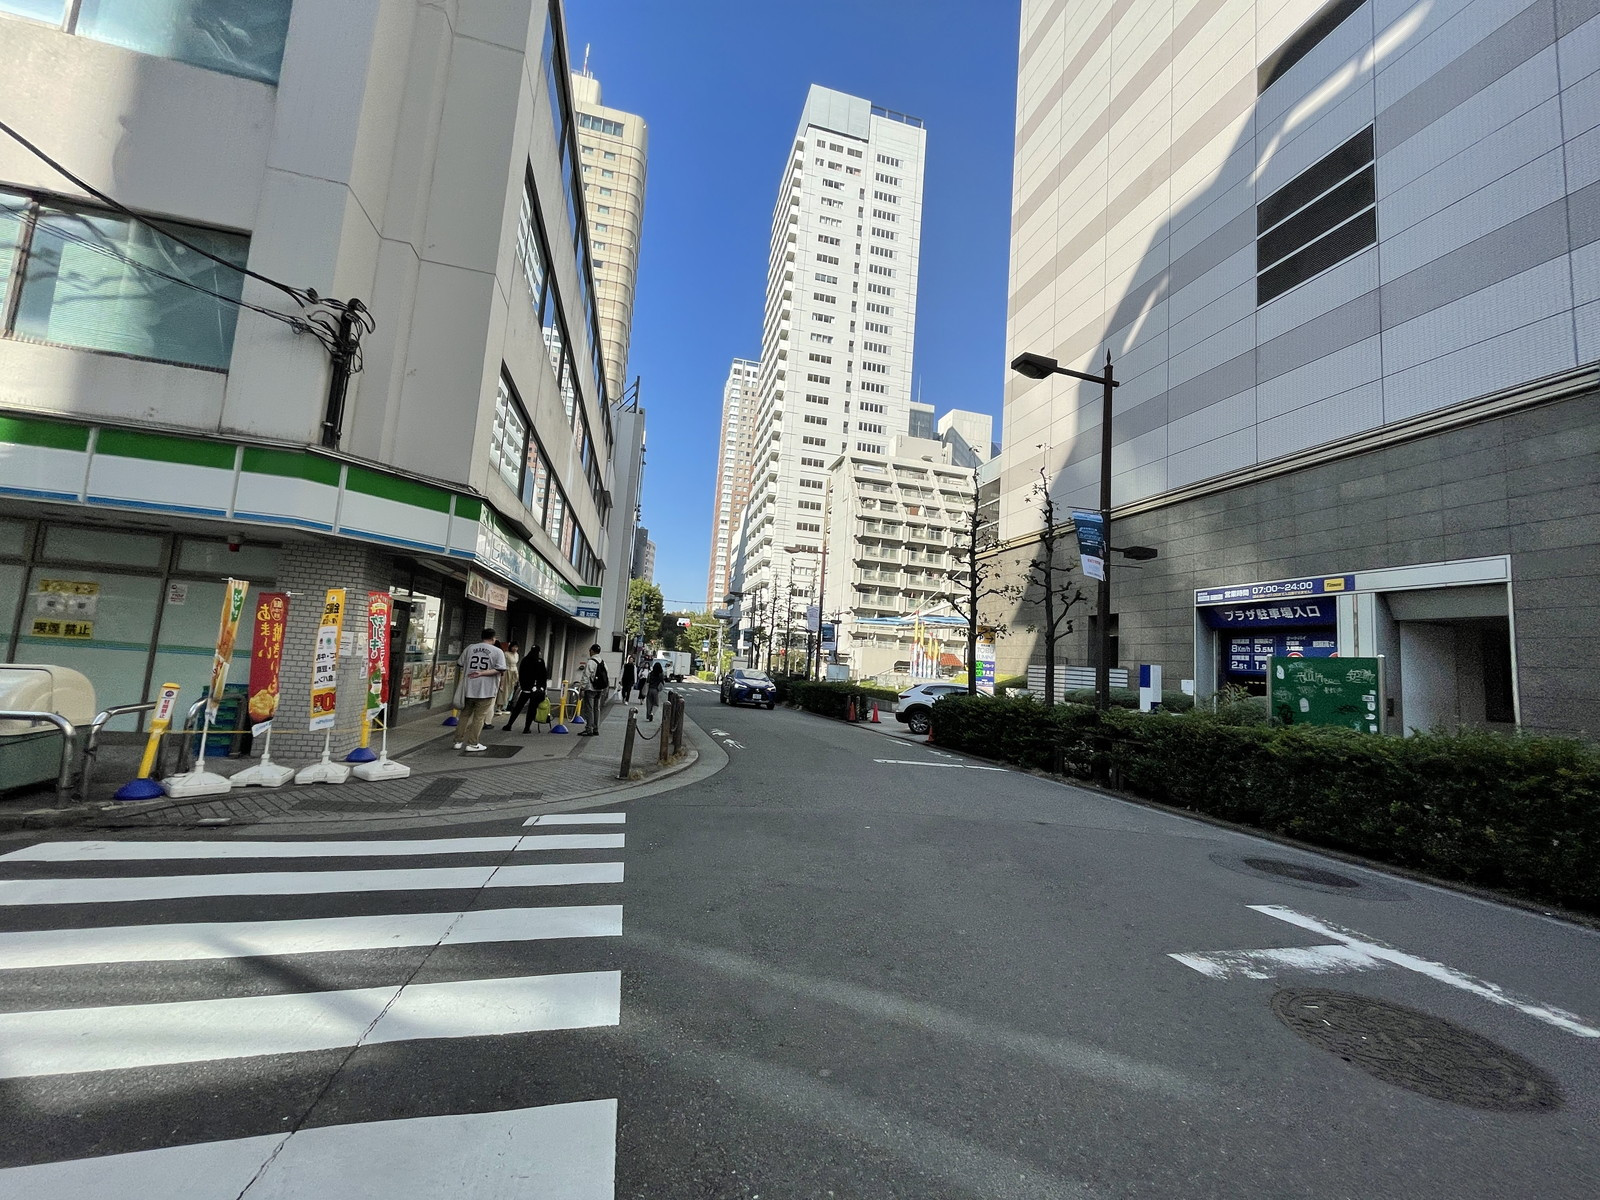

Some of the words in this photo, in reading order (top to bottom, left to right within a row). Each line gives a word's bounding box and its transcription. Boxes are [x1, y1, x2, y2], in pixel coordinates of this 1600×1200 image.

[1224, 605, 1321, 621] プラザ駐車場入口
[470, 655, 490, 671] 25
